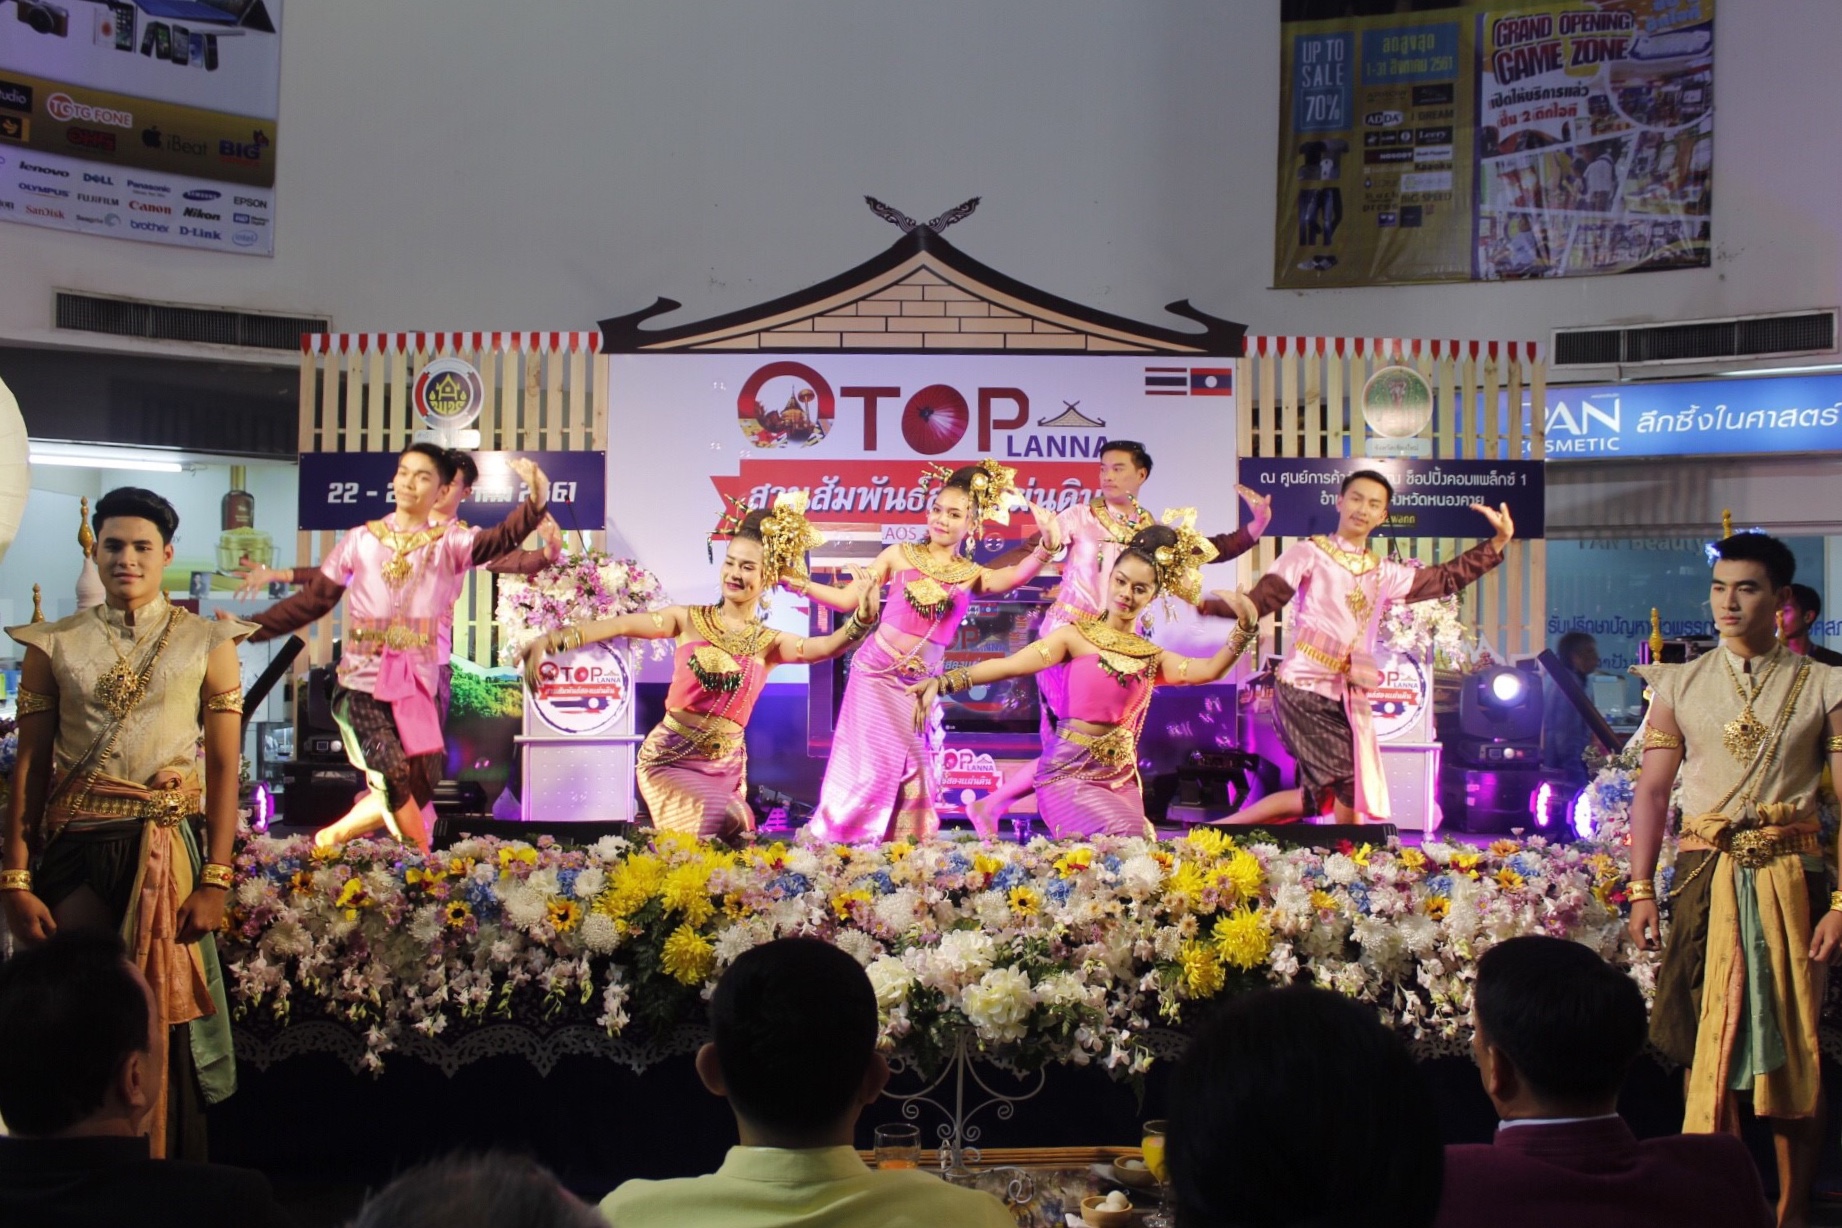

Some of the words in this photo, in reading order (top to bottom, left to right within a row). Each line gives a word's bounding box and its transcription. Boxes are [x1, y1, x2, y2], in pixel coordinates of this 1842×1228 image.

[1495, 15, 1551, 46] GRAND
[1560, 12, 1633, 34] OPENING
[1302, 42, 1321, 65] UP
[1327, 38, 1344, 62] TO
[1495, 41, 1563, 85] GAME
[1571, 38, 1630, 66] ZONE
[1302, 63, 1344, 88] SALE
[75, 106, 91, 117] TG
[94, 109, 132, 126] FONE
[1305, 94, 1341, 123] 70%
[1522, 110, 1531, 122] 2
[1367, 114, 1400, 124] ADDA
[166, 134, 208, 156] iBeat
[219, 139, 260, 160] BIG
[19, 161, 70, 178] lenovo
[83, 172, 114, 186] DELL
[127, 179, 171, 194] Panasonic
[18, 182, 70, 198] OLYMPUS
[77, 193, 119, 207] FUJIFILM
[129, 200, 172, 215] Canon
[233, 195, 267, 209] EPSON
[25, 204, 65, 219] SanDisk
[183, 206, 222, 221] Nikon
[130, 219, 170, 233] brother
[180, 226, 222, 241] D-Link
[737, 360, 1030, 456] OTOP
[1520, 474, 1527, 486] 1
[328, 482, 358, 504] 22
